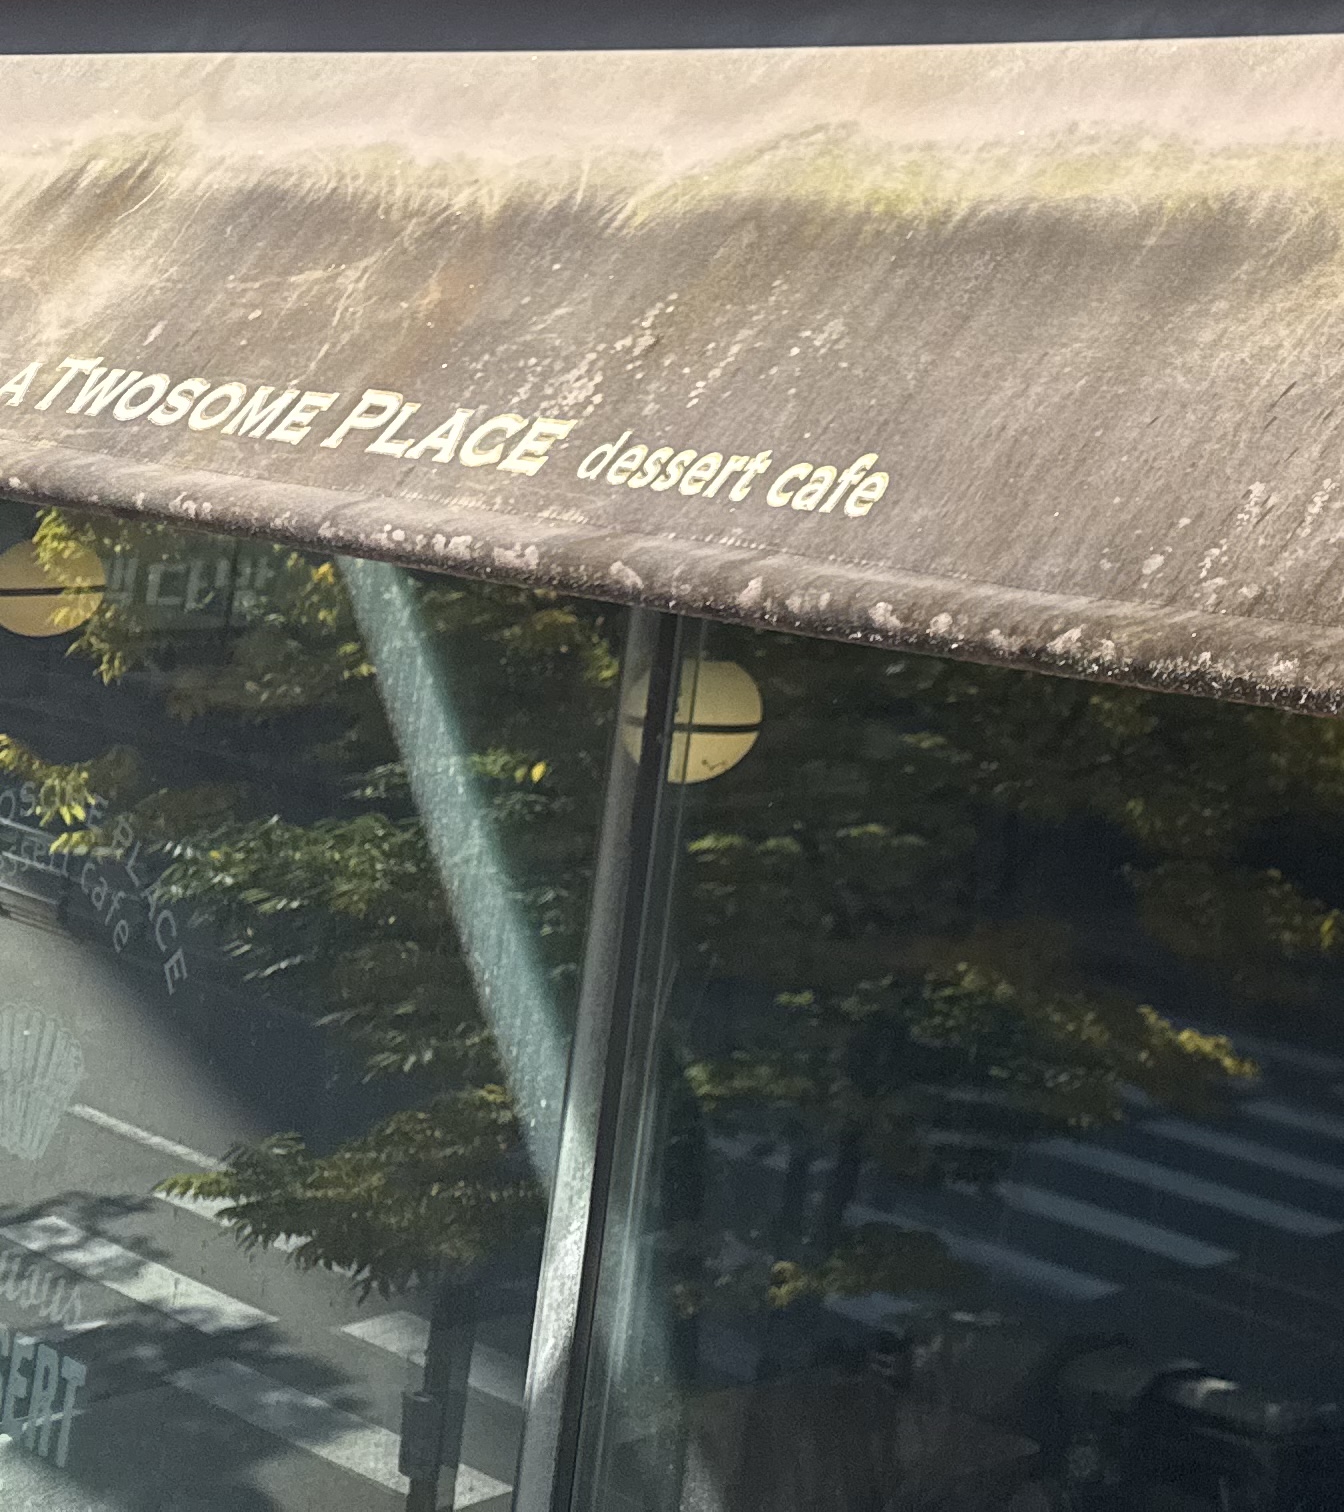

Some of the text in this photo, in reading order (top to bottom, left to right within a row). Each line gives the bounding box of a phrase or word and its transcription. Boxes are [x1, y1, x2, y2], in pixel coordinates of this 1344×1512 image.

[0, 356, 890, 518] A TWOSOME PLACE dessert cafe
